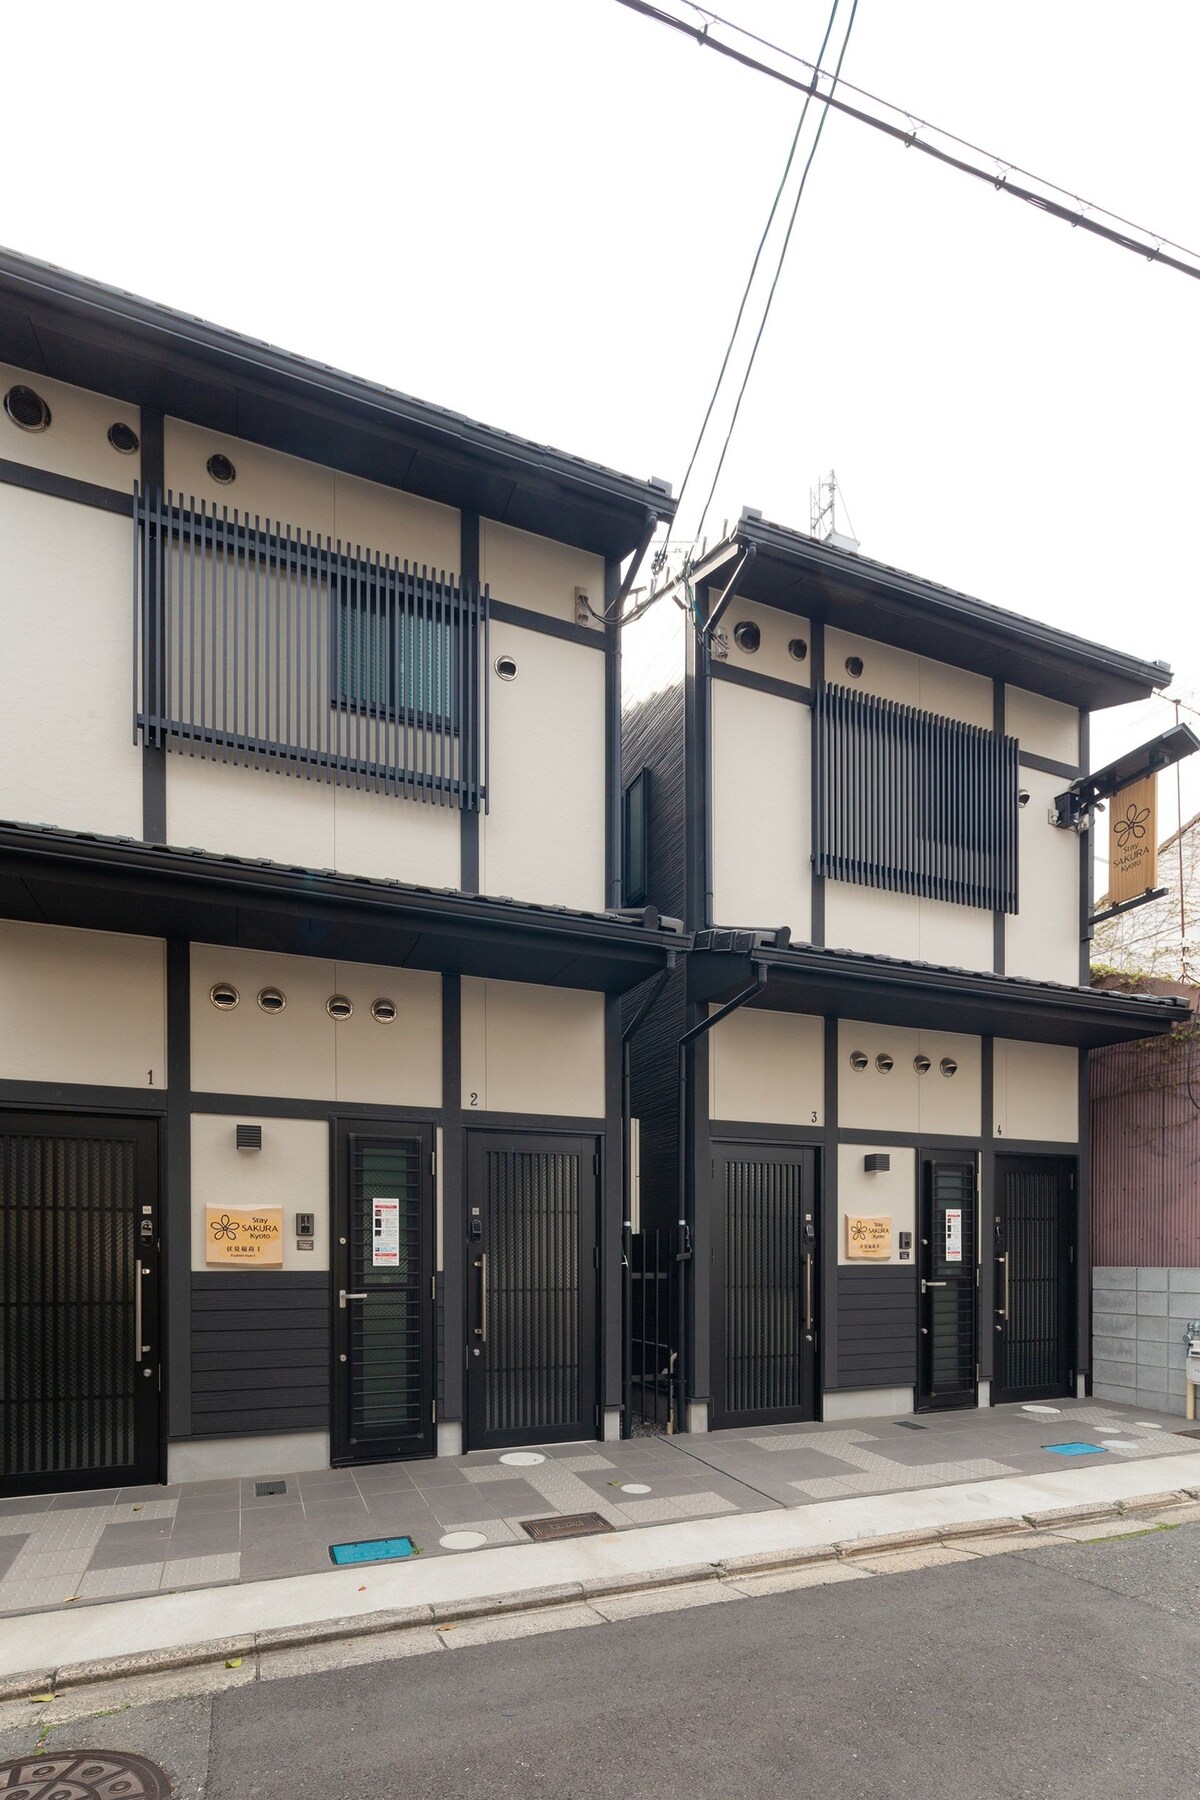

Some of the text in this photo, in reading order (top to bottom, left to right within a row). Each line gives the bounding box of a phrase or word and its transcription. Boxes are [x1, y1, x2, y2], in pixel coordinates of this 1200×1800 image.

[1123, 842, 1139, 853] Stay
[1113, 846, 1149, 868] SAKURA
[1120, 859, 1142, 872] Kyoto
[147, 1069, 153, 1085] 1
[470, 1092, 478, 1106] 2
[811, 1111, 818, 1123] 3
[997, 1124, 1002, 1136] 4
[252, 1216, 268, 1224] Stay
[241, 1224, 278, 1232] SAKURA
